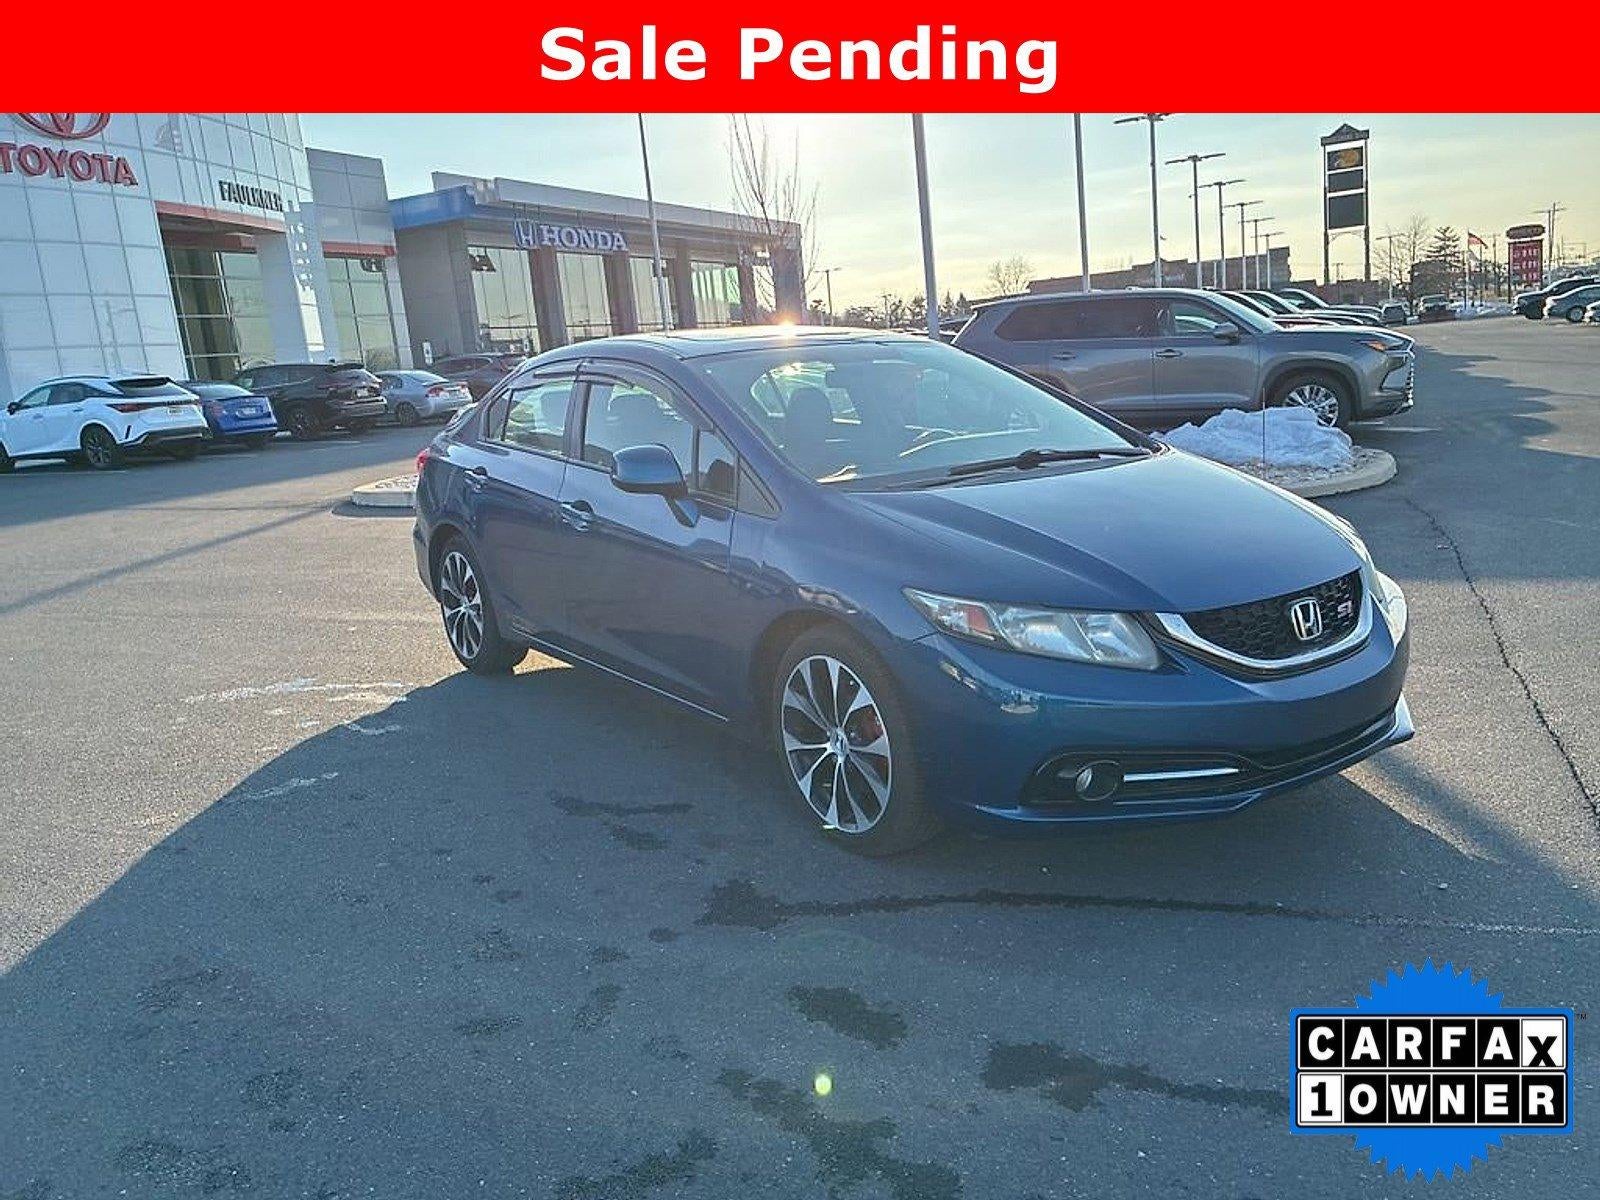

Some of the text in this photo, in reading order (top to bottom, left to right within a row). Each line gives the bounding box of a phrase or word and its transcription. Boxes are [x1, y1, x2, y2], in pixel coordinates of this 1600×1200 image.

[0, 142, 139, 186] TOYOTA
[219, 180, 284, 212] FAULKNER
[539, 224, 628, 252] HONDA
